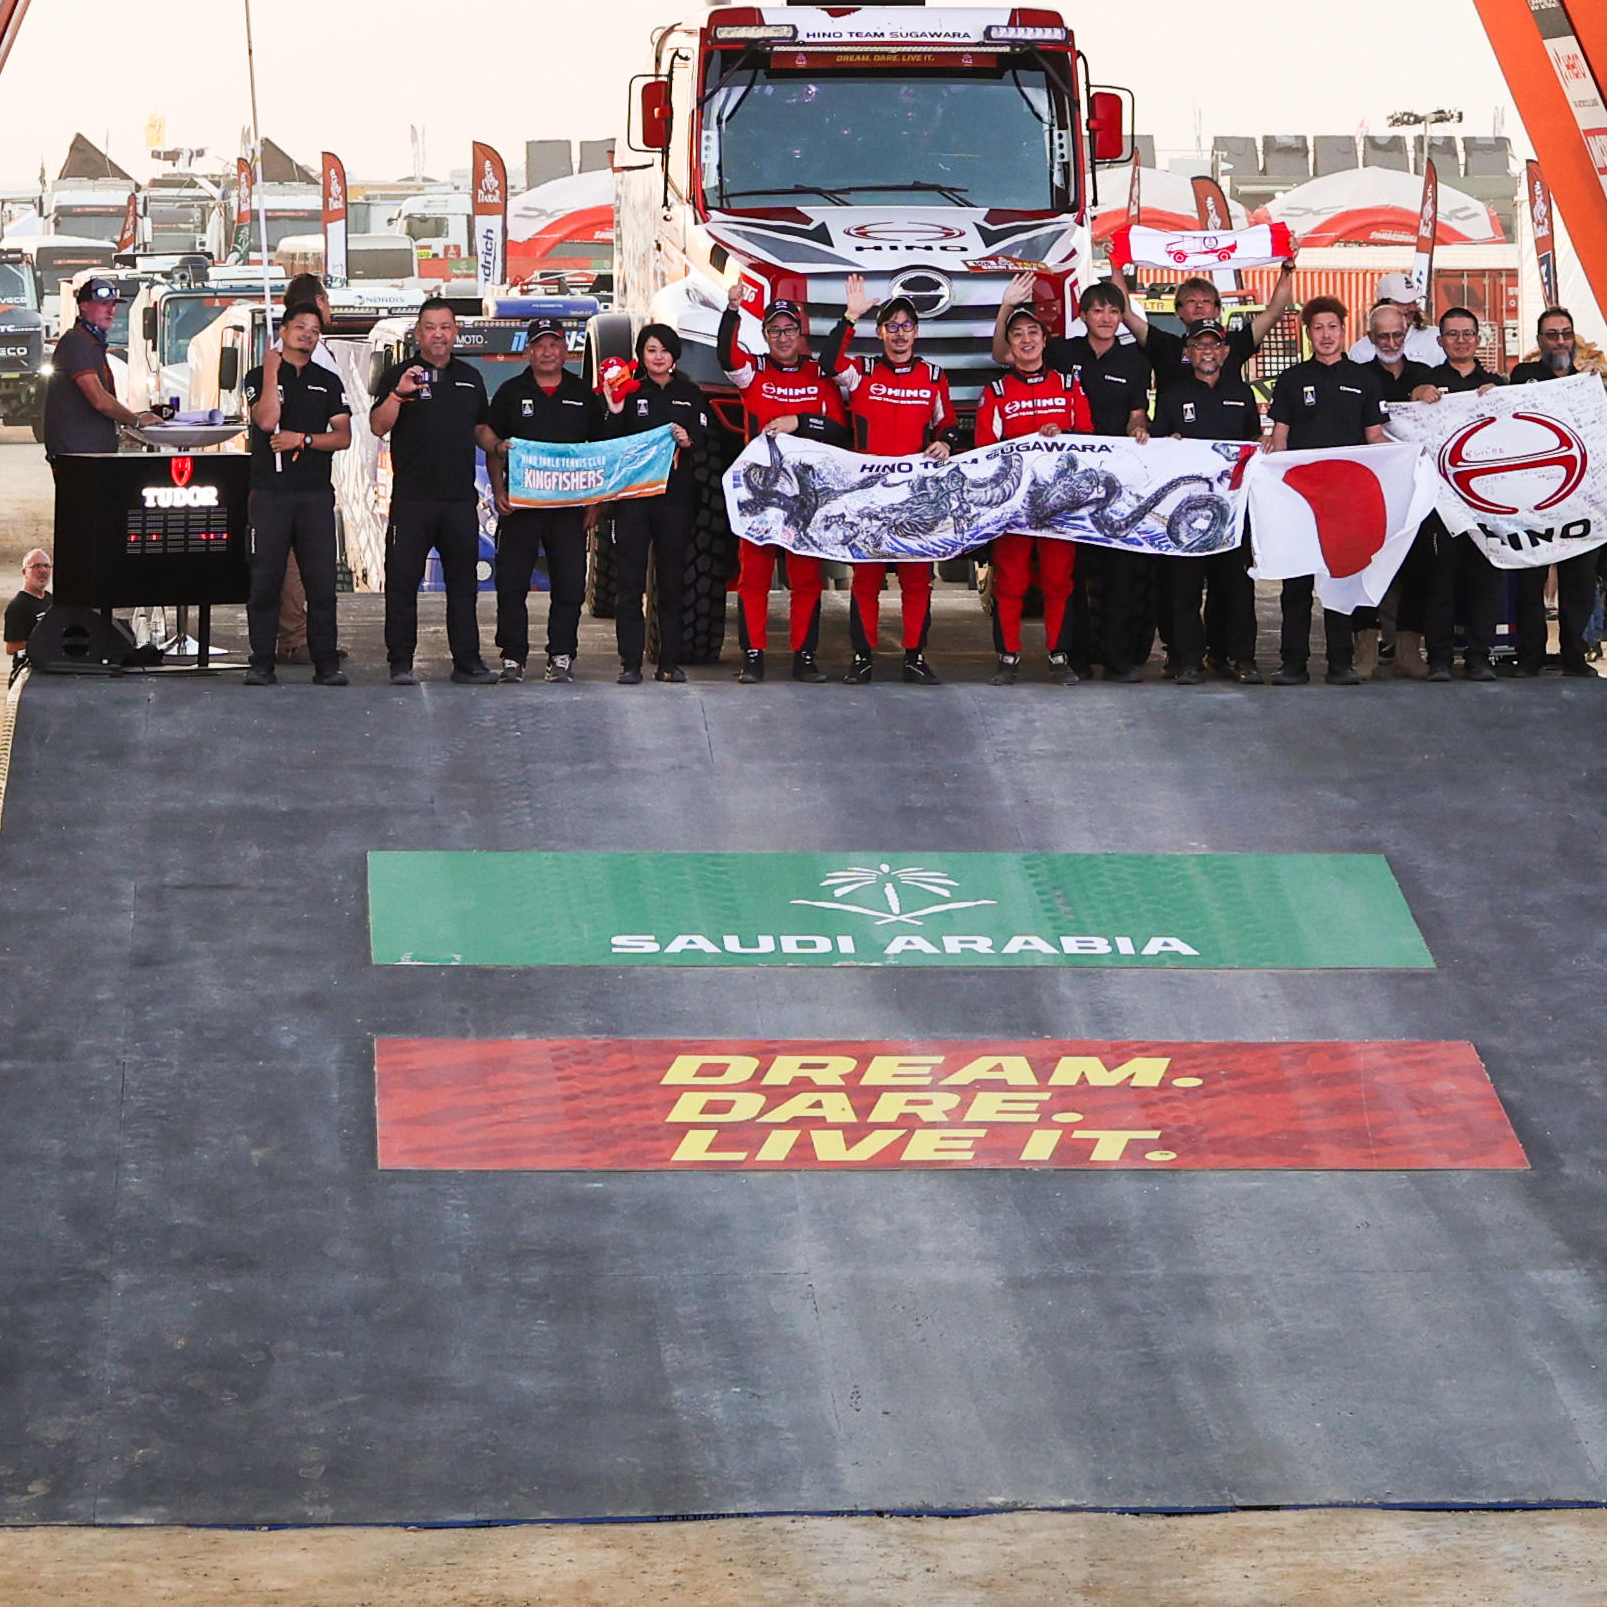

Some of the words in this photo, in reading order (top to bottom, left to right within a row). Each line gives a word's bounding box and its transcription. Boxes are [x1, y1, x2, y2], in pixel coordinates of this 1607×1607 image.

[806, 31, 843, 39] HINO
[847, 31, 885, 39] TEAM
[889, 31, 972, 39] SUGAWARA
[481, 228, 495, 283] drich
[776, 386, 819, 396] HINO
[887, 388, 932, 398] HINO
[1020, 397, 1067, 409] HINO
[860, 461, 914, 474] HINO
[523, 467, 605, 492] KINGFISHERS
[141, 485, 219, 508] TUDOR
[610, 933, 857, 955] SAUDI
[882, 934, 1202, 956] ARABIA
[659, 1054, 1205, 1088] DREAM.
[663, 1091, 1085, 1124] DARE.
[670, 1128, 978, 1162] LIVE
[1012, 1128, 1181, 1162] IT.
